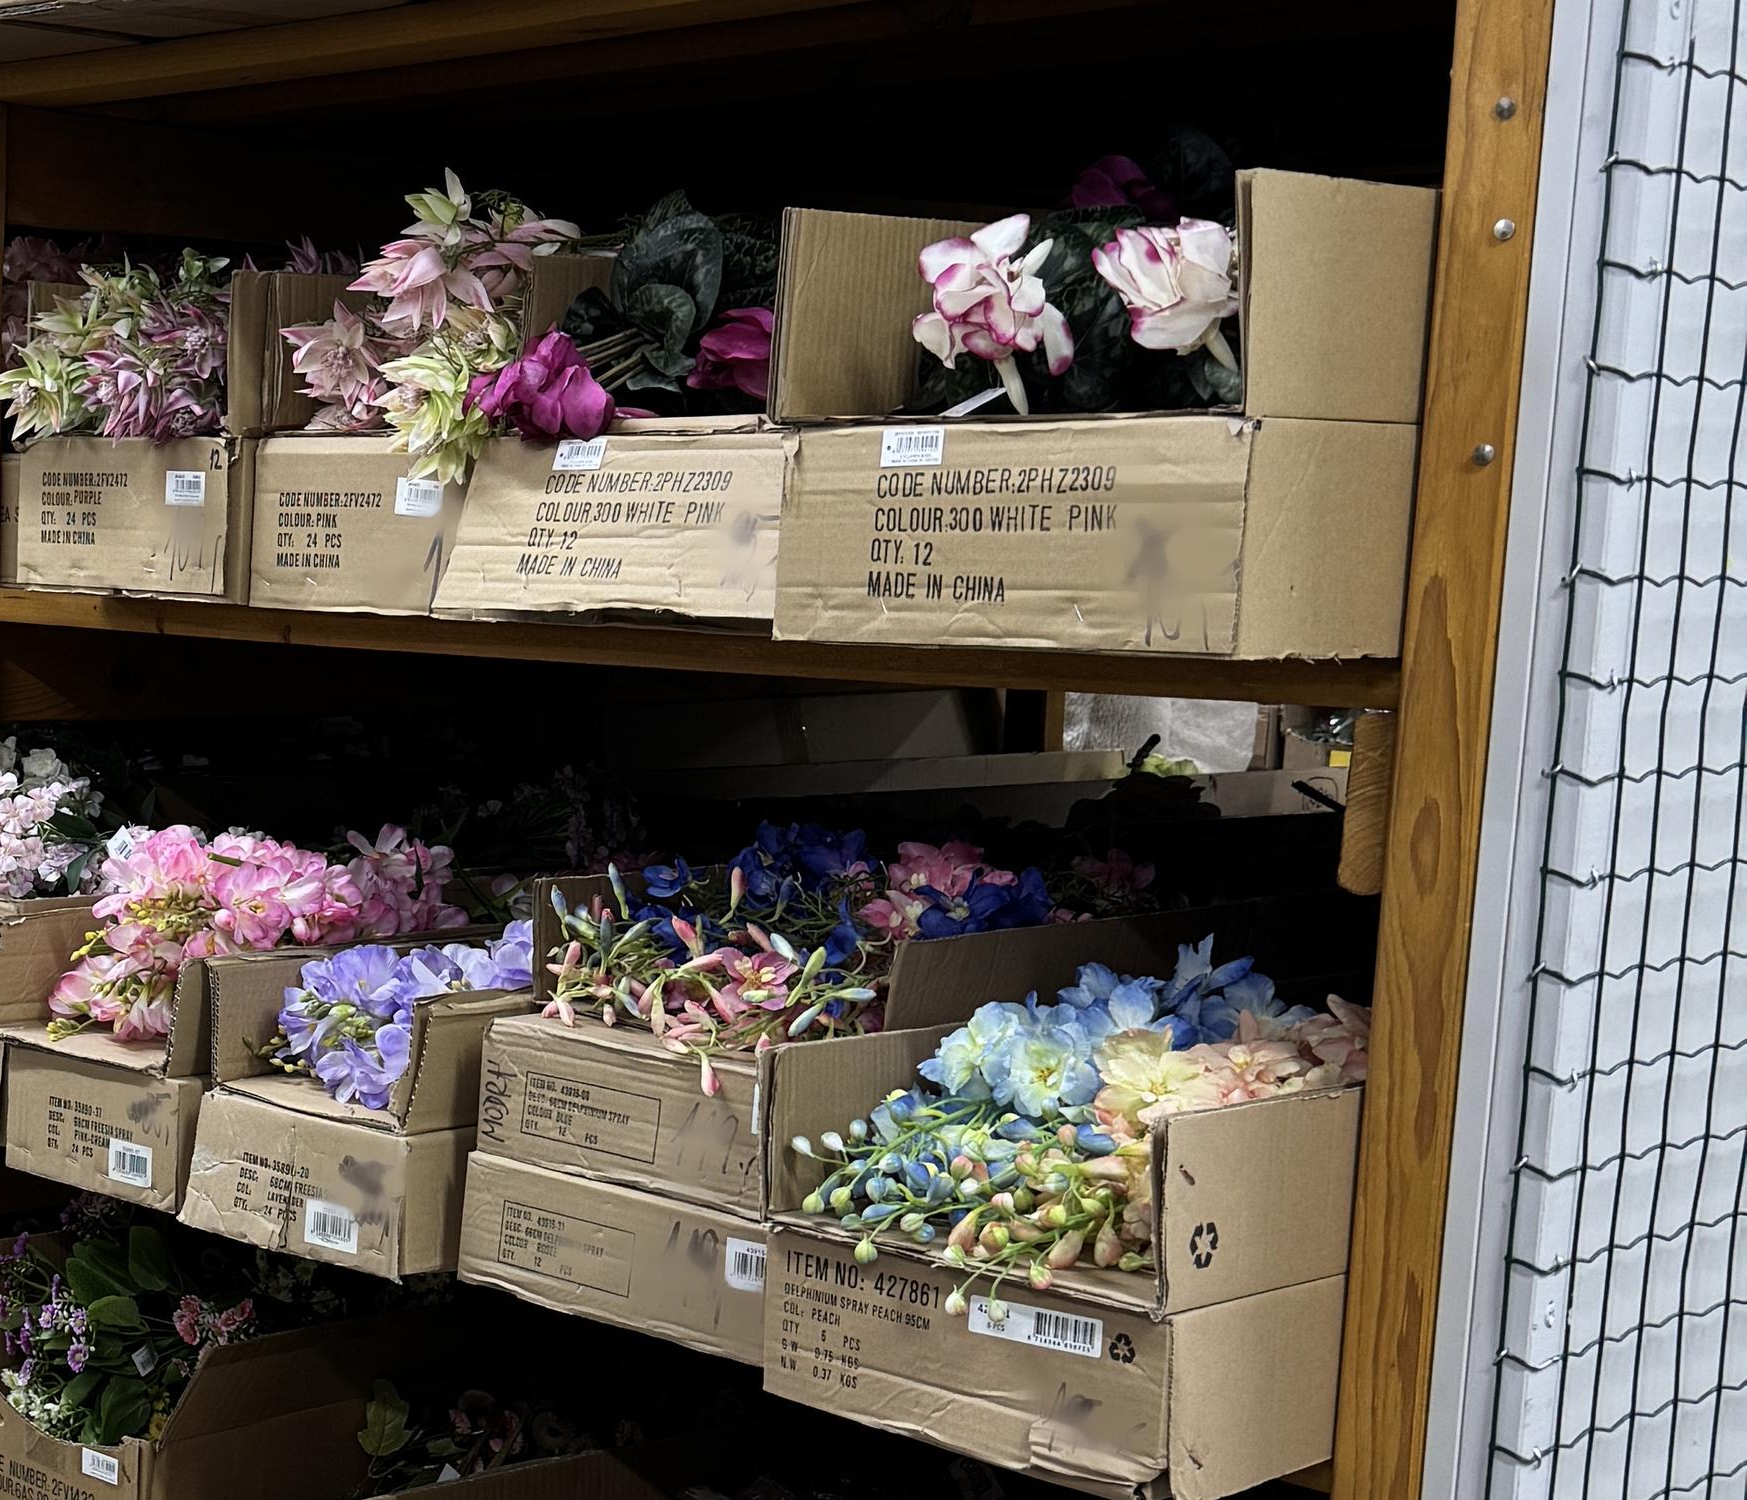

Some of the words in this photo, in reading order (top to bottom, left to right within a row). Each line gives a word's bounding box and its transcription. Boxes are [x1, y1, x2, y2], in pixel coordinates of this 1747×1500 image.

[42, 472, 61, 487] CODE
[545, 474, 584, 495] CODE
[877, 472, 925, 499] CODE
[930, 465, 1117, 497] NUMBER:2PHZ2309
[41, 490, 73, 507] COLOUR:
[73, 489, 102, 506] PURPLE
[279, 492, 302, 508] CODE
[41, 510, 57, 526] QTY:
[65, 511, 76, 526] 24
[81, 512, 97, 527] PCS
[278, 512, 314, 528] COLOUR:
[315, 513, 338, 528] PINK
[625, 501, 676, 524] WHITE
[684, 502, 726, 525] PINK
[989, 505, 1052, 532] WHITE
[1068, 504, 1118, 532] PINK
[41, 530, 61, 544] MADE
[62, 530, 71, 545] IN
[72, 530, 95, 545] CHINA
[277, 533, 294, 548] QTY:
[306, 534, 317, 548] 24
[324, 534, 342, 549] PCS
[560, 530, 578, 551] 12
[276, 553, 300, 568] MADE
[301, 554, 311, 568] IN
[313, 554, 340, 569] CHINA
[870, 538, 904, 565] QTY:
[913, 542, 934, 566] 12
[516, 553, 555, 576] MADE
[559, 555, 576, 577] IN
[580, 556, 623, 580] CHINA
[867, 571, 916, 599] MADE
[925, 573, 943, 599] IN
[952, 576, 1005, 603] CHINA
[558, 1126, 567, 1137] 12
[71, 1144, 79, 1154] 24
[81, 1145, 94, 1158] PCS
[243, 1152, 259, 1169] ITEM
[295, 1182, 323, 1200] FREESIA
[263, 1205, 272, 1217] 24
[533, 1256, 542, 1268] 12
[785, 1249, 829, 1283] ITEM
[835, 1260, 866, 1292] NO:
[873, 1272, 941, 1310] 427861
[783, 1282, 838, 1306] DELPHINIUM
[839, 1296, 870, 1316] SPRAY
[871, 1305, 904, 1325] PEACH
[905, 1314, 931, 1331] 95CM
[811, 1308, 841, 1328] PEACH
[820, 1330, 827, 1344] 6
[843, 1336, 862, 1352] PCS
[812, 1366, 833, 1384] 0.37
[839, 1372, 859, 1390] KGS
